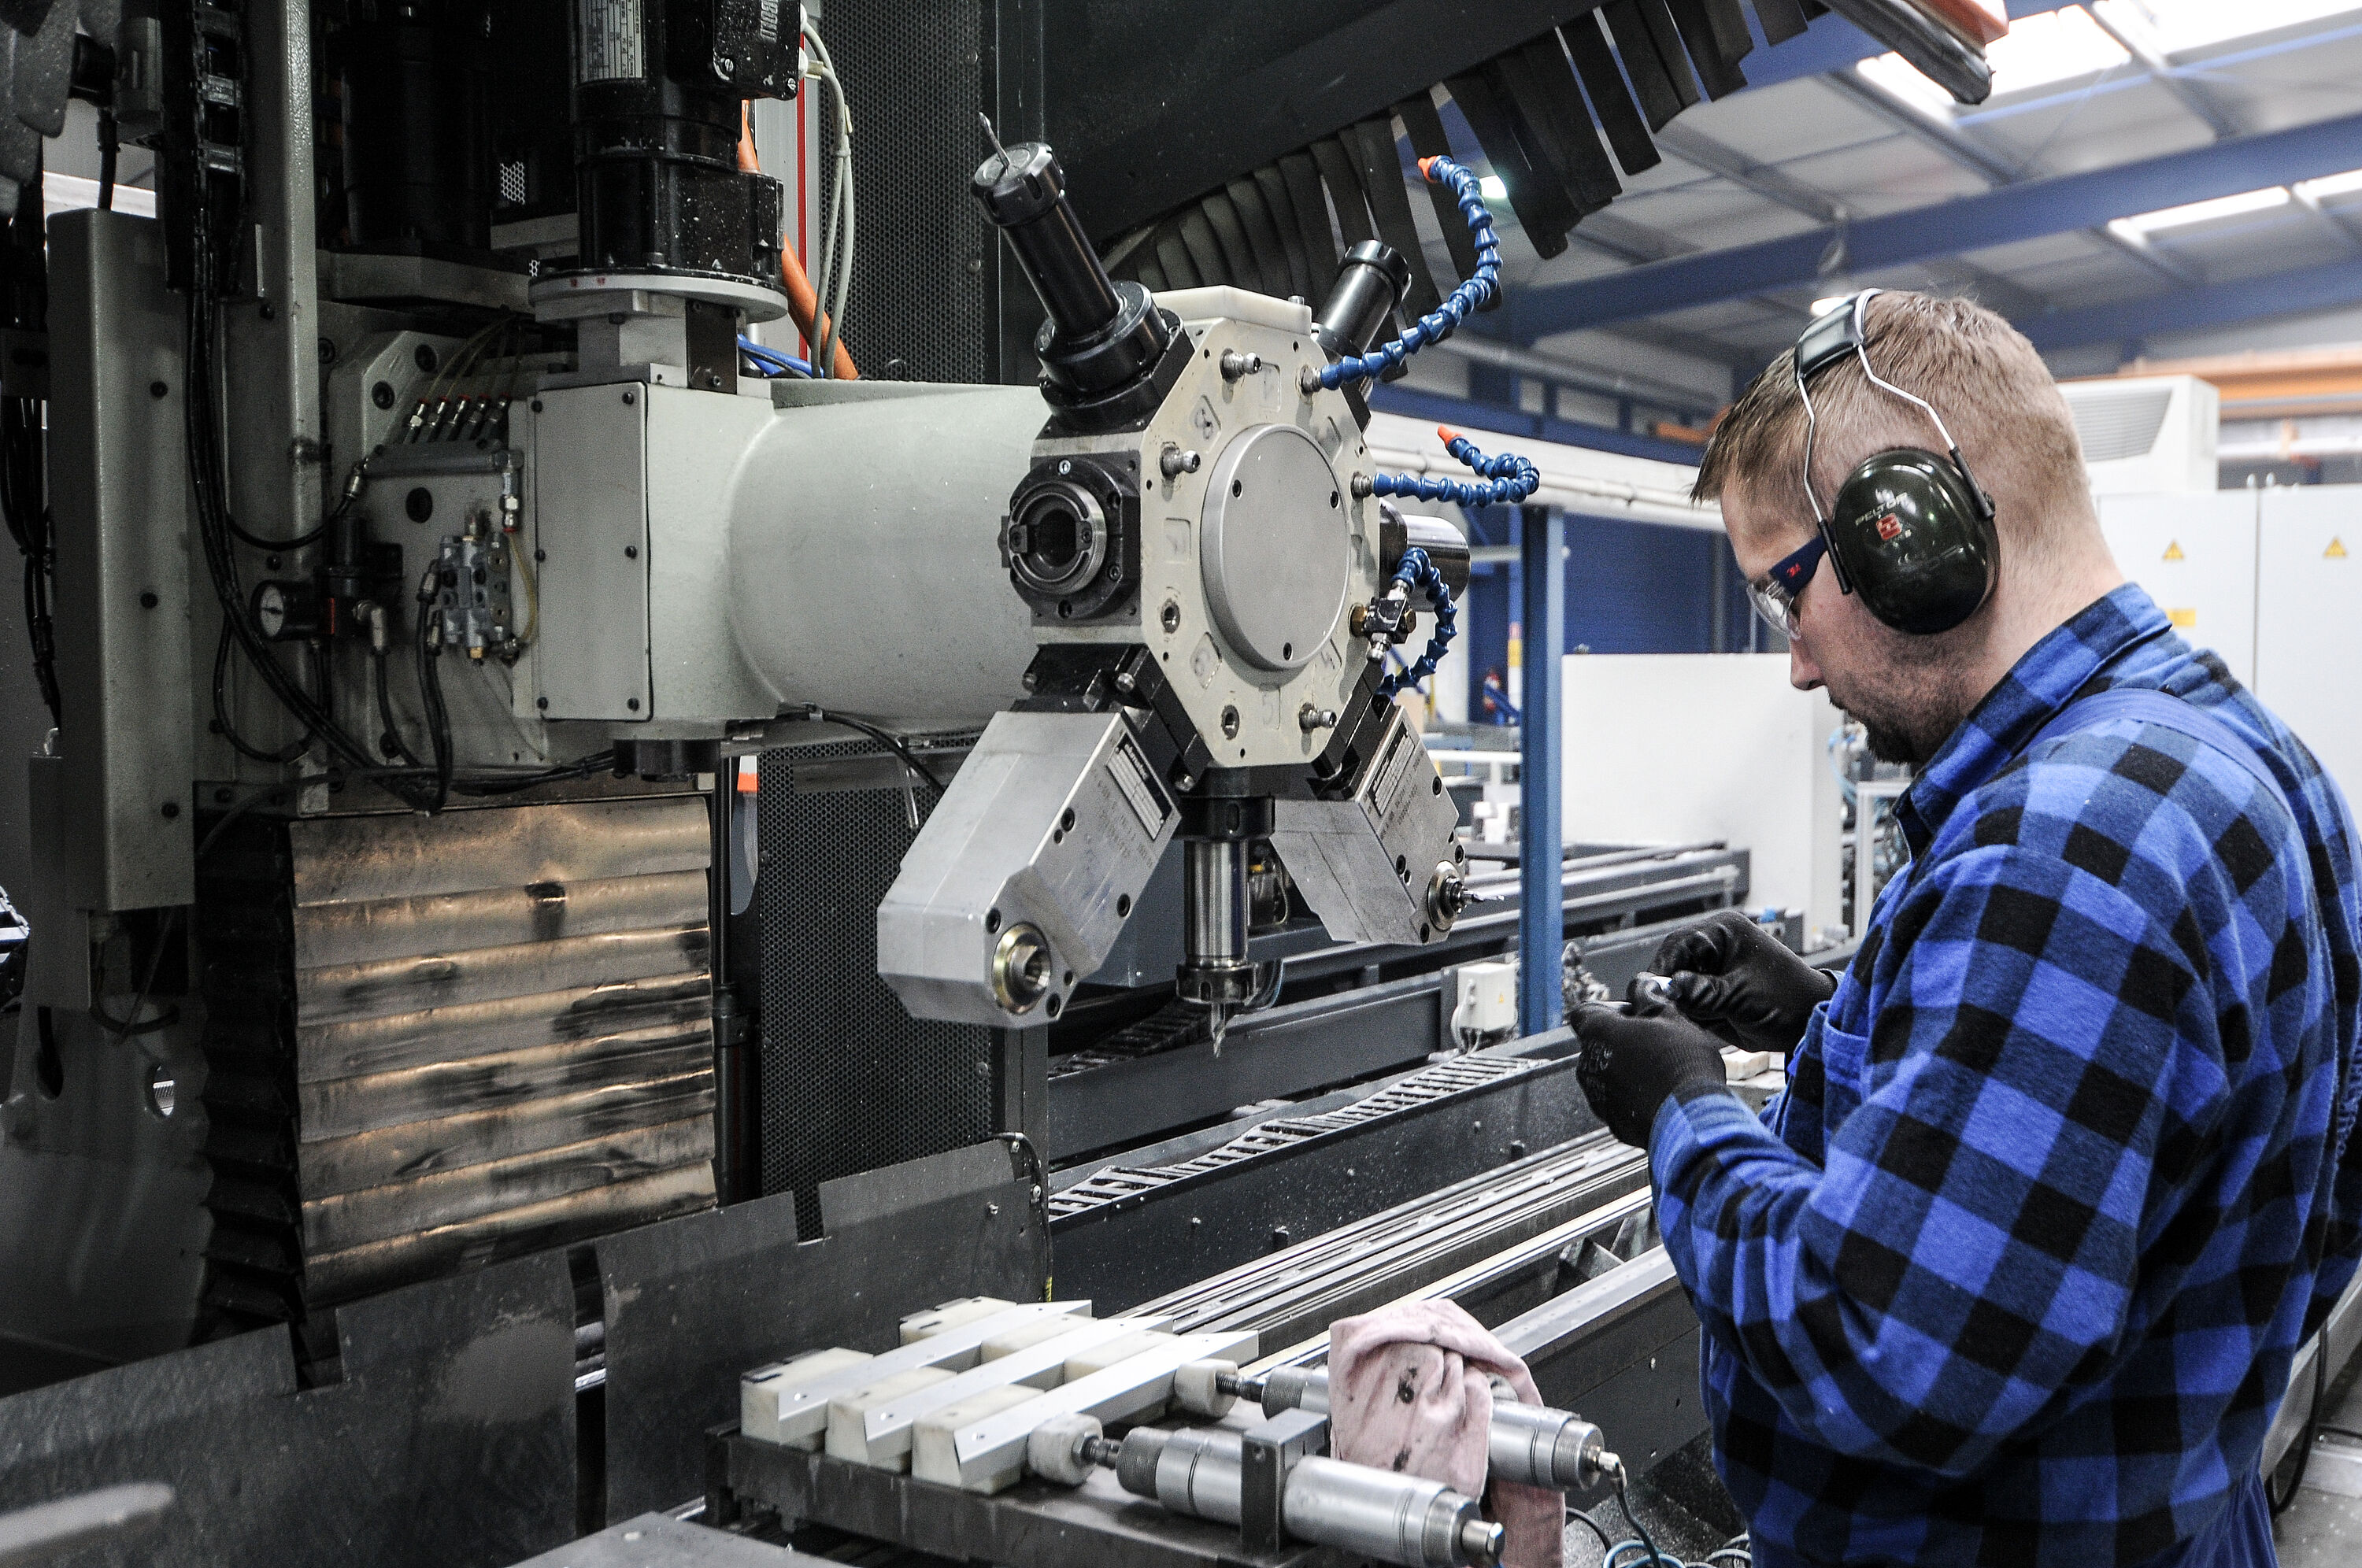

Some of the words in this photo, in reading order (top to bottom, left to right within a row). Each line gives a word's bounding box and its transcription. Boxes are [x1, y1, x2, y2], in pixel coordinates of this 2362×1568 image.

[761, 0, 778, 43] BOLD
[1855, 492, 1908, 526] PELTOR
[1786, 563, 1801, 579] 3M
[1124, 743, 1150, 781] elumatec
